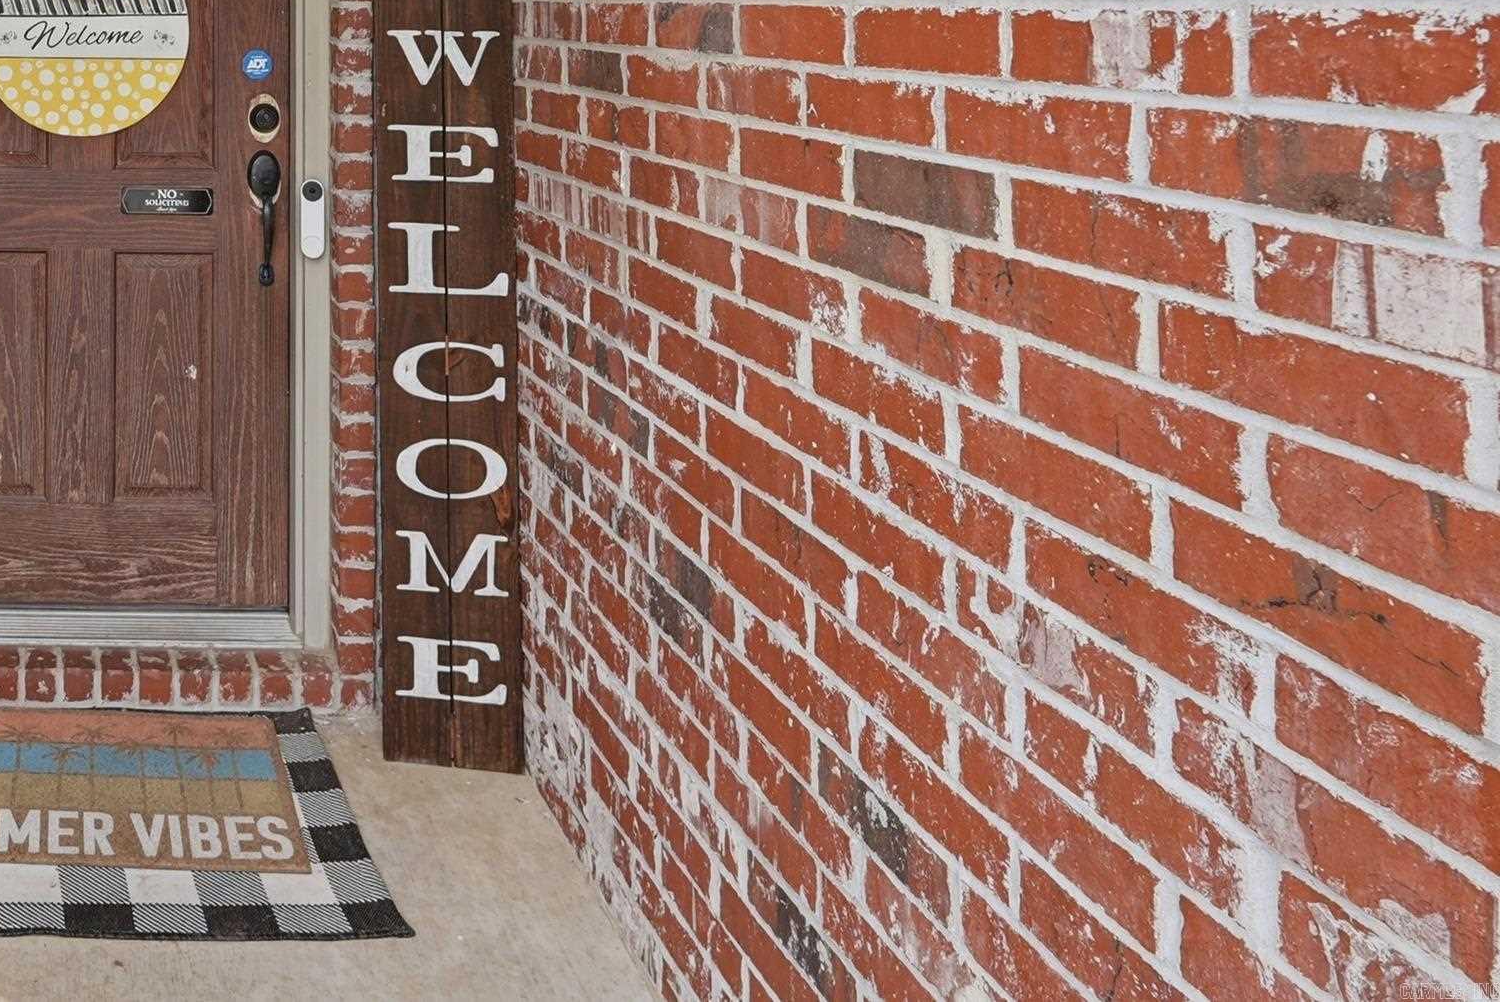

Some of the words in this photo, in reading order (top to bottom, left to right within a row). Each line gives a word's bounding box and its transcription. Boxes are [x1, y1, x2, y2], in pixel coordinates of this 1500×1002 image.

[23, 20, 144, 50] Welcome
[247, 58, 268, 68] ADT
[144, 199, 190, 207] SOLICITING
[157, 189, 178, 199] NO
[387, 29, 509, 706] WELCOME
[129, 812, 294, 860] VIBES
